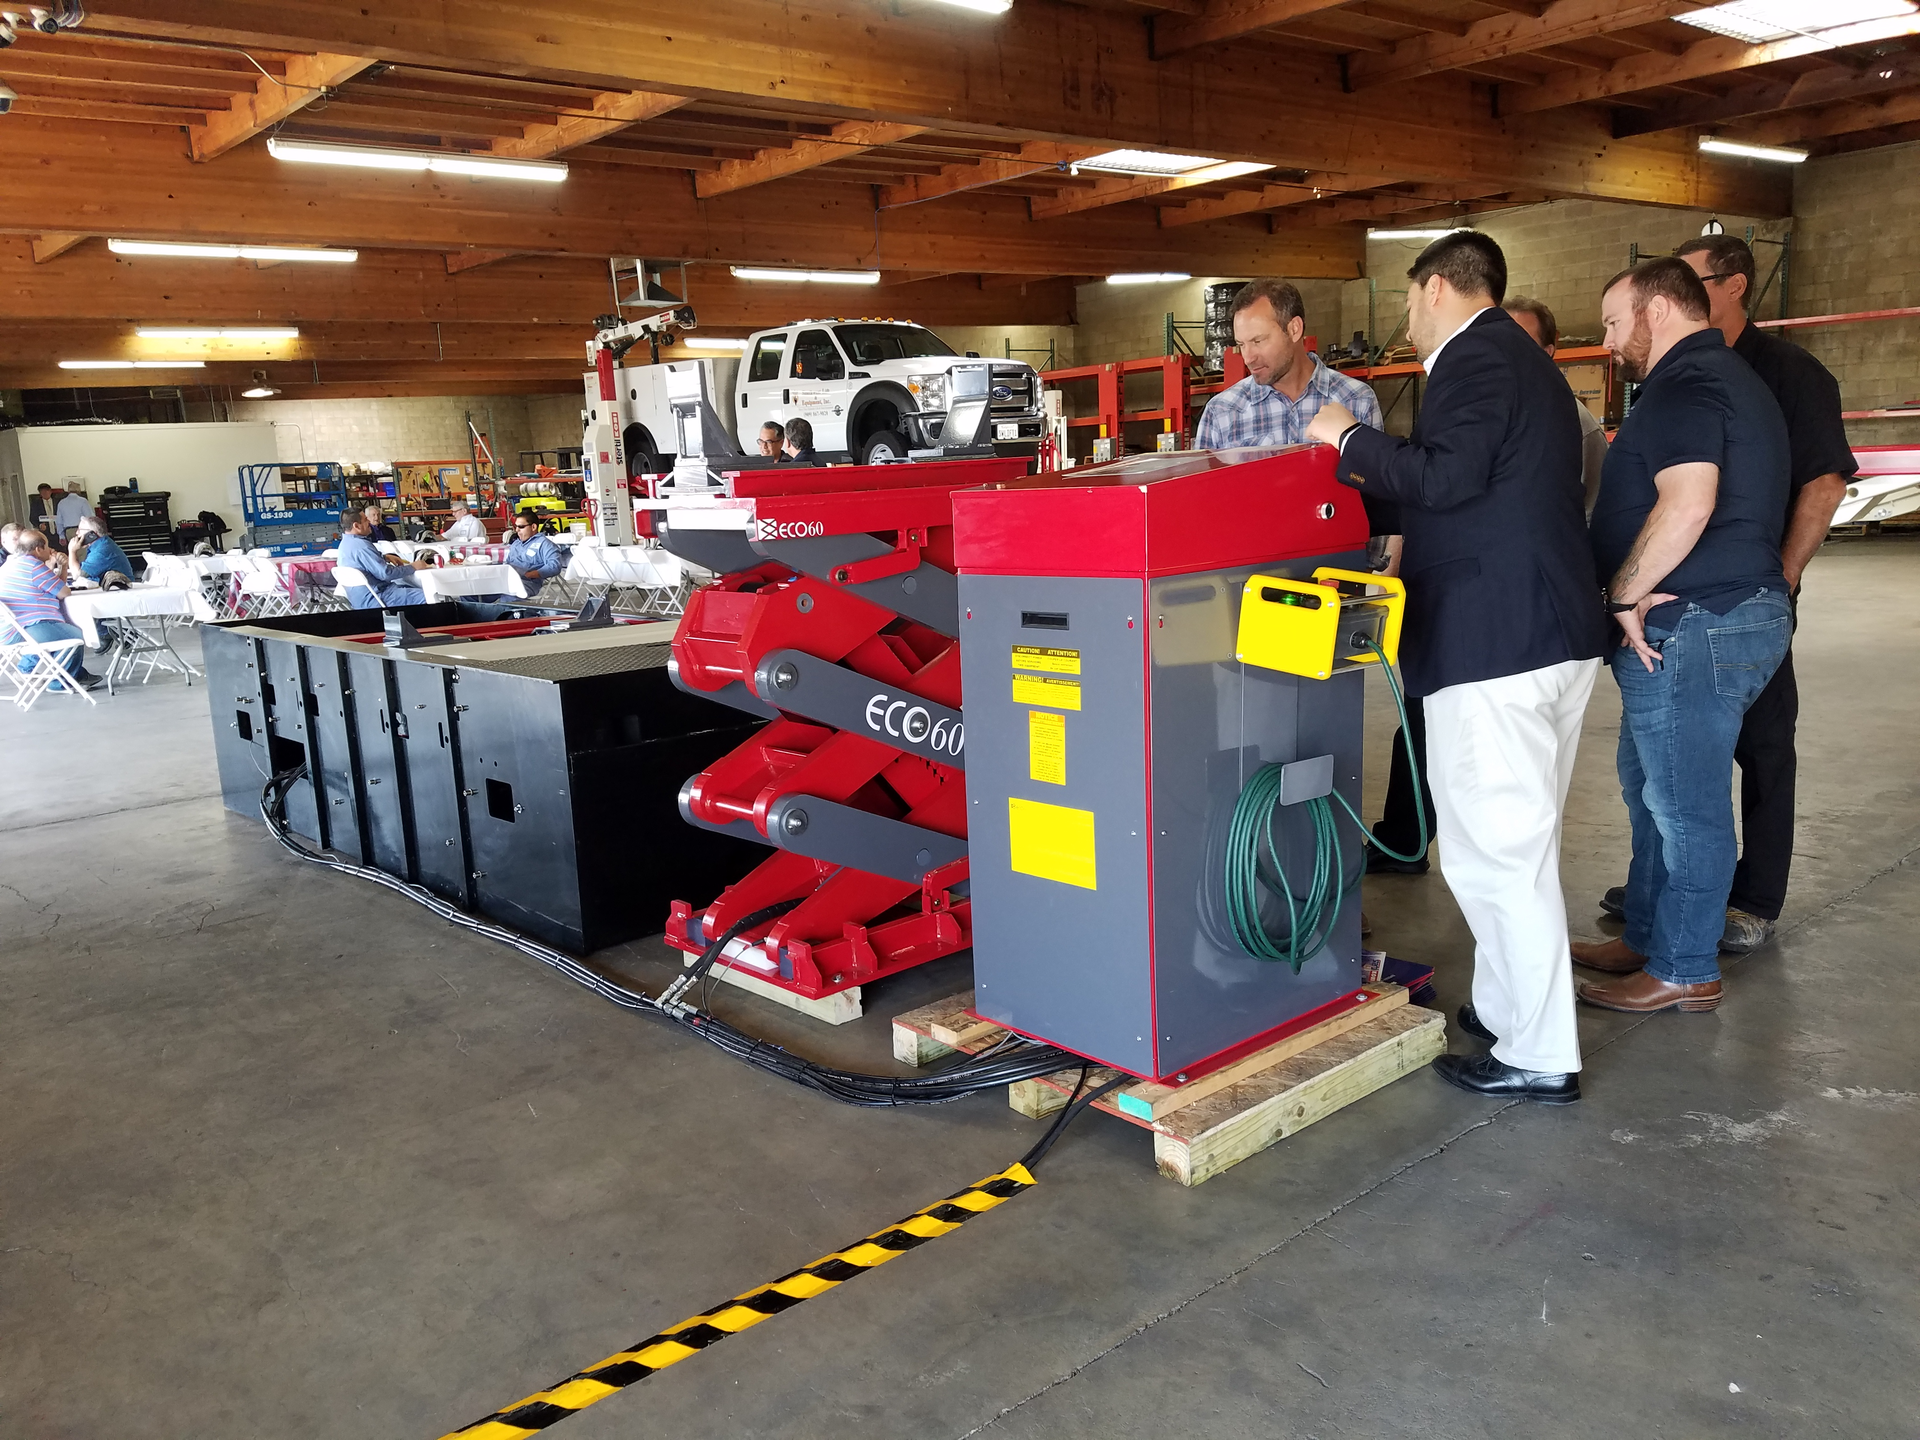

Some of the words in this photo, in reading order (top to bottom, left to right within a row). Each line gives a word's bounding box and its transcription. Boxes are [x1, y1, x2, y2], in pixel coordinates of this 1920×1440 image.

[260, 511, 293, 519] GS-1930
[779, 521, 824, 539] ECO60
[1047, 649, 1078, 657] ATTENTION!
[1014, 674, 1044, 683] WARNING!
[866, 694, 965, 756] ECO60
